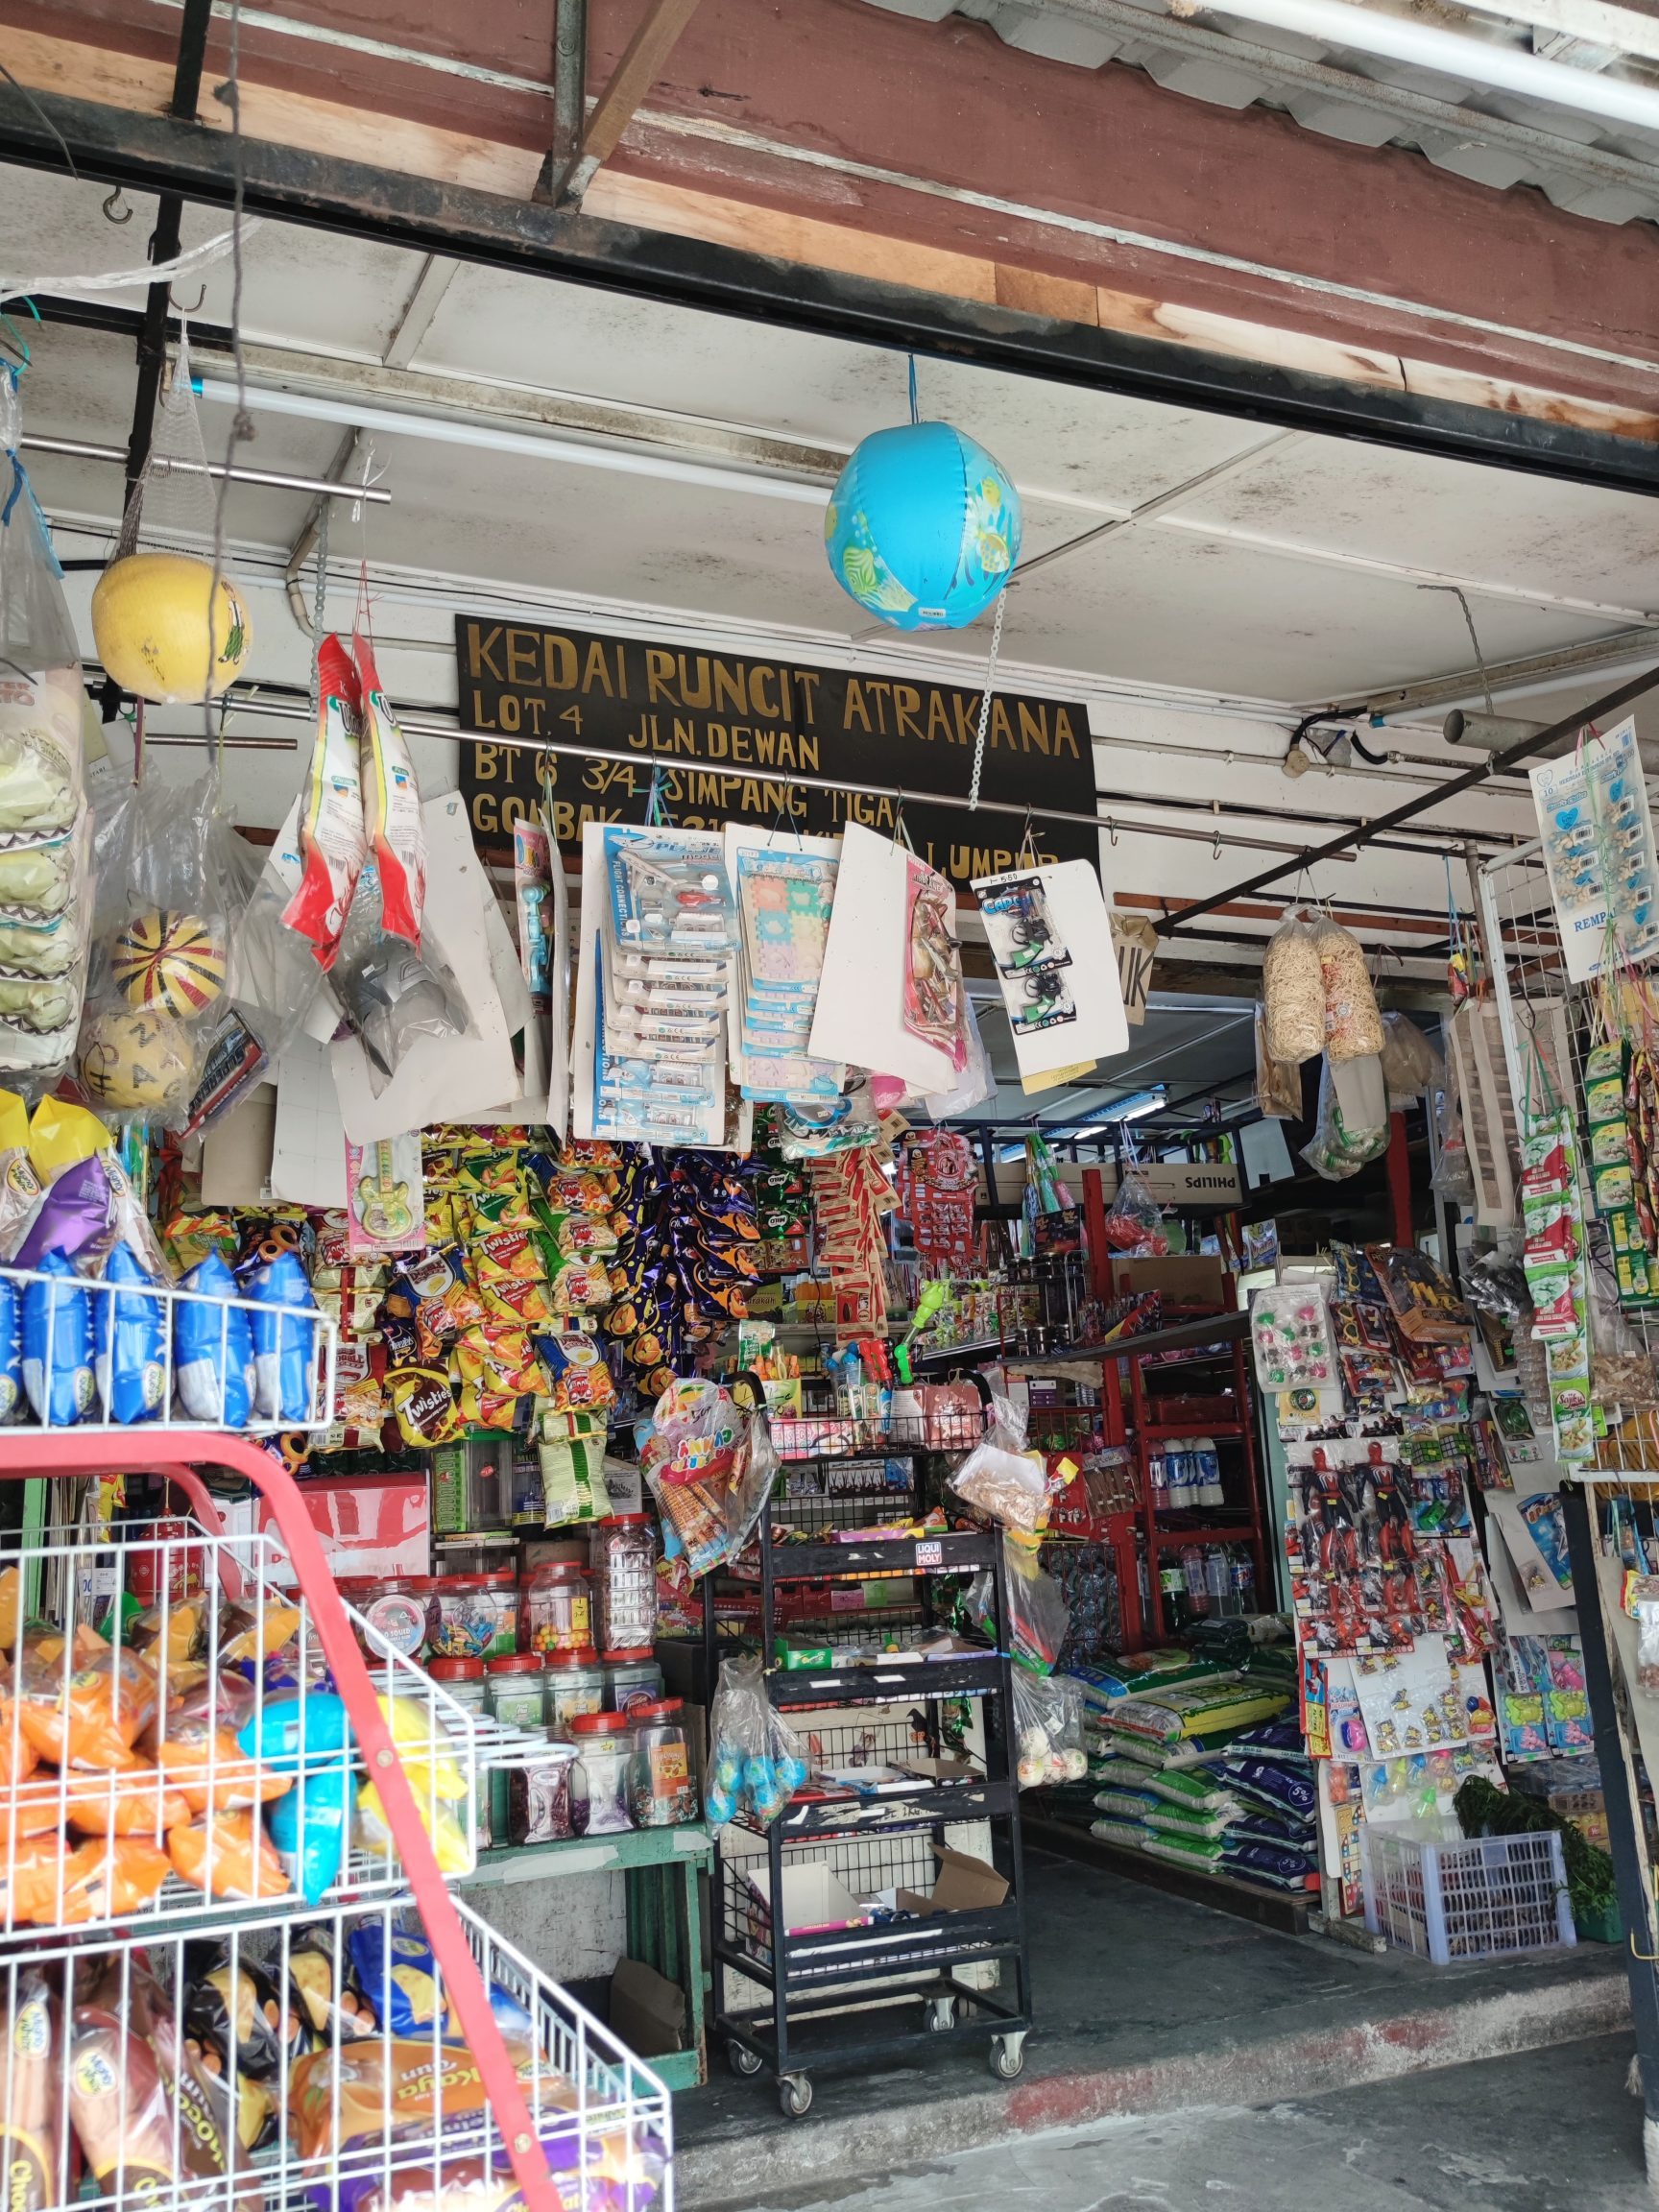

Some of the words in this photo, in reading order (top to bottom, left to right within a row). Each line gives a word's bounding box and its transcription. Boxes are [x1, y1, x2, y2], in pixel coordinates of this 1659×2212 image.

[468, 624, 628, 699] KEDAI
[646, 649, 819, 725] RUNCIT
[843, 679, 1080, 759] ATRAKANA
[559, 705, 584, 734] 4
[475, 743, 520, 783] BT
[535, 752, 559, 786] 6
[582, 757, 636, 797] 3/4
[665, 768, 807, 816] SIMPANG
[824, 790, 895, 828] TIGA
[613, 860, 623, 883] FLIGHT
[1186, 1176, 1237, 1190] PHILIPS
[397, 1388, 452, 1427] Twisties
[918, 1544, 940, 1553] LIQUI
[918, 1553, 941, 1564] MOLY
[1292, 1786, 1310, 1802] 5%
